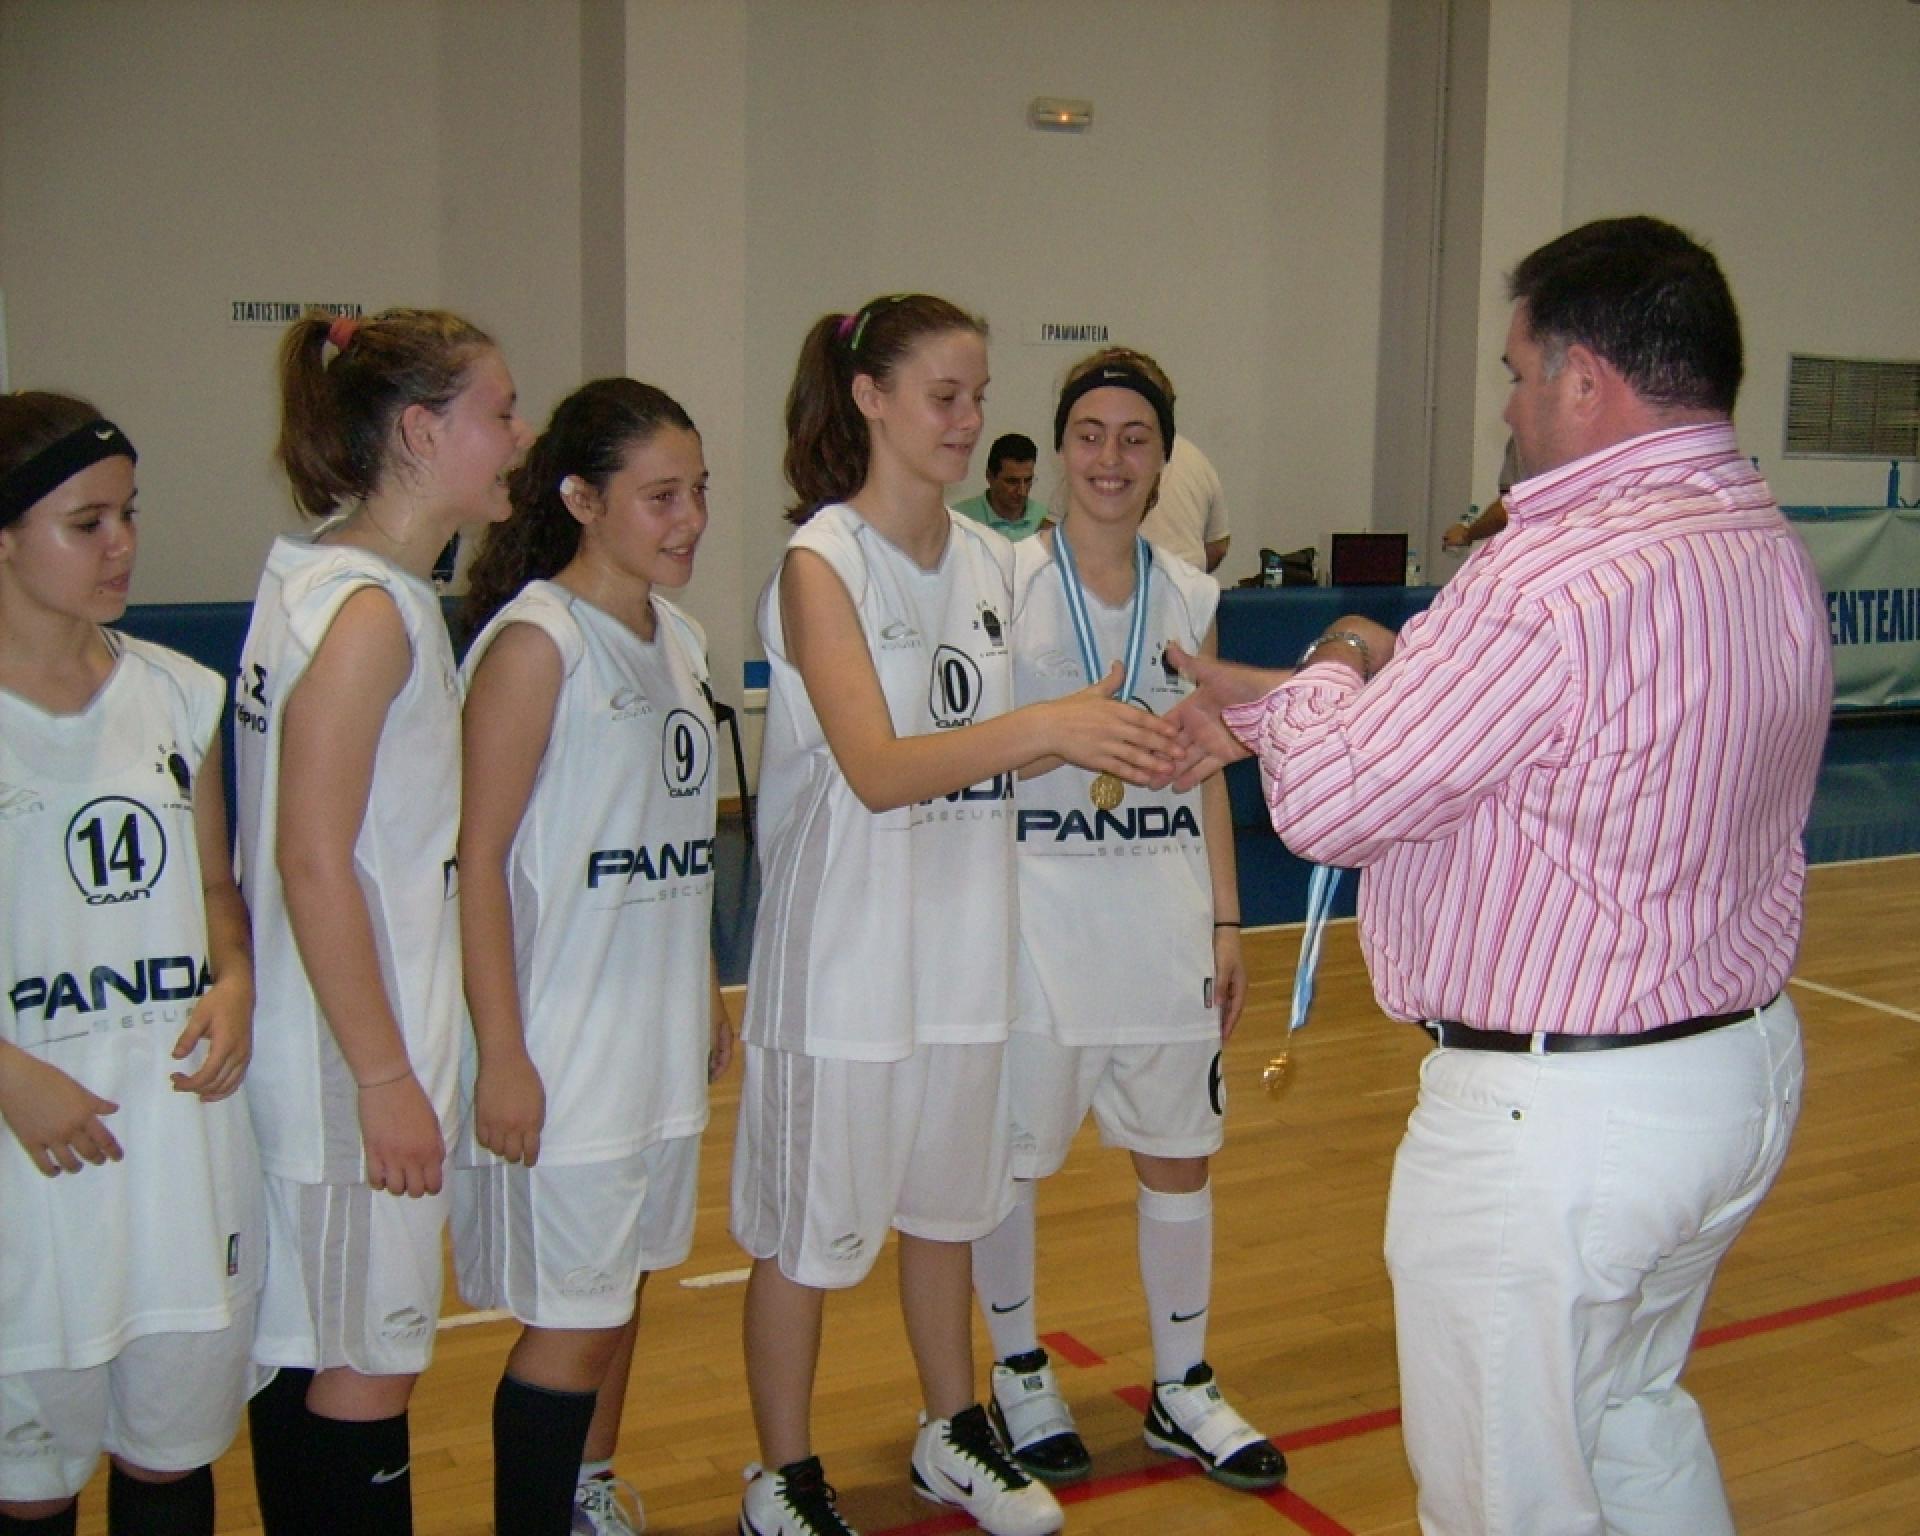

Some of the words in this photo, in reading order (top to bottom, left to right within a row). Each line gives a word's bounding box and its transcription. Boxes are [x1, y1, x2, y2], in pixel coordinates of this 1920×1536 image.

[1041, 324, 1109, 342] ΓΡΑΜΜΑΤΕΙΑ
[938, 658, 970, 714] 10
[674, 723, 695, 783] 9
[1016, 804, 1201, 842] PANDA
[76, 813, 146, 887] 14
[587, 837, 716, 889] PAND
[93, 1006, 194, 1033] SECU
